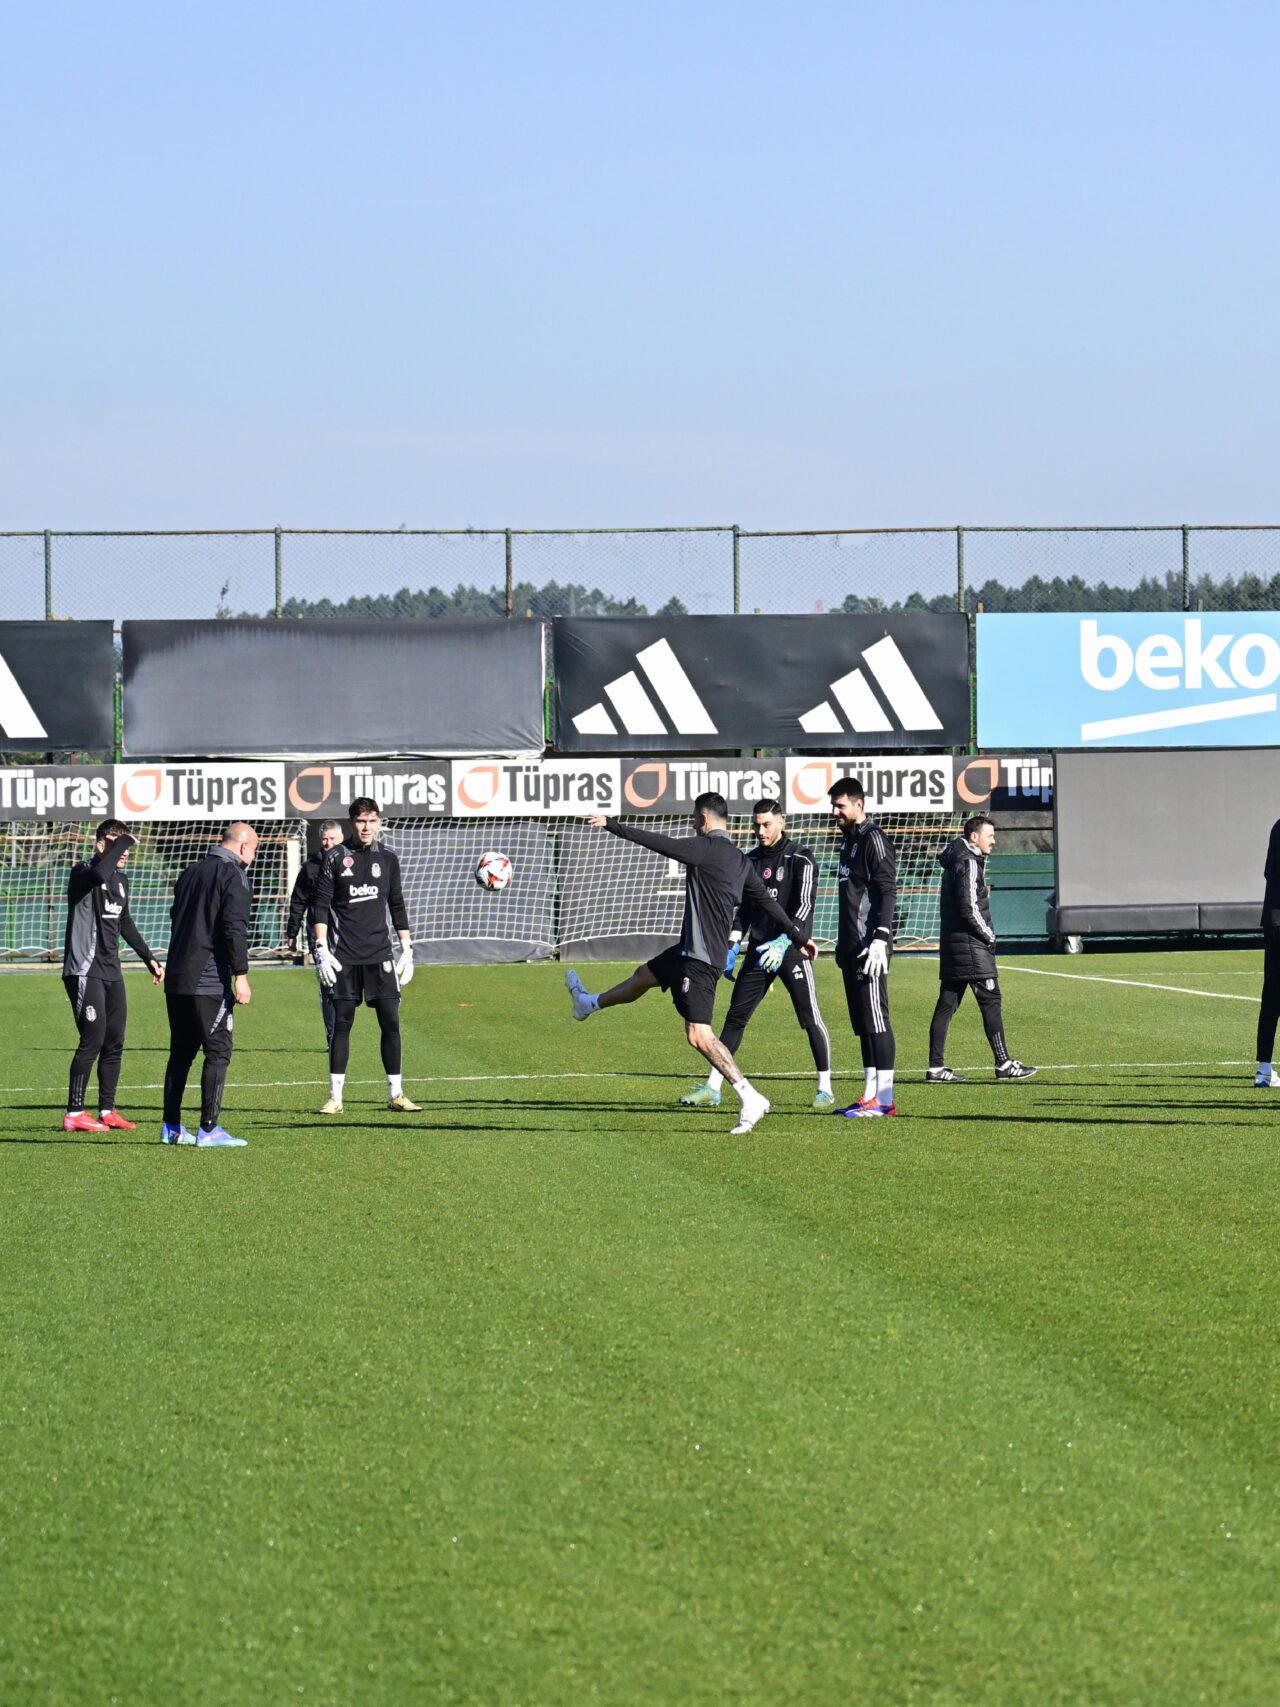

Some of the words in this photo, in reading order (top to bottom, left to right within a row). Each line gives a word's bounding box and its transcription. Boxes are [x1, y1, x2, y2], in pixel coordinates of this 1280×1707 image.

[0, 769, 109, 815] Tüpraş
[166, 768, 277, 812] Tüpraş
[334, 766, 446, 812] Tüpraş
[503, 765, 613, 808] Tüpraş
[104, 899, 123, 915] beko
[349, 883, 379, 897] beko
